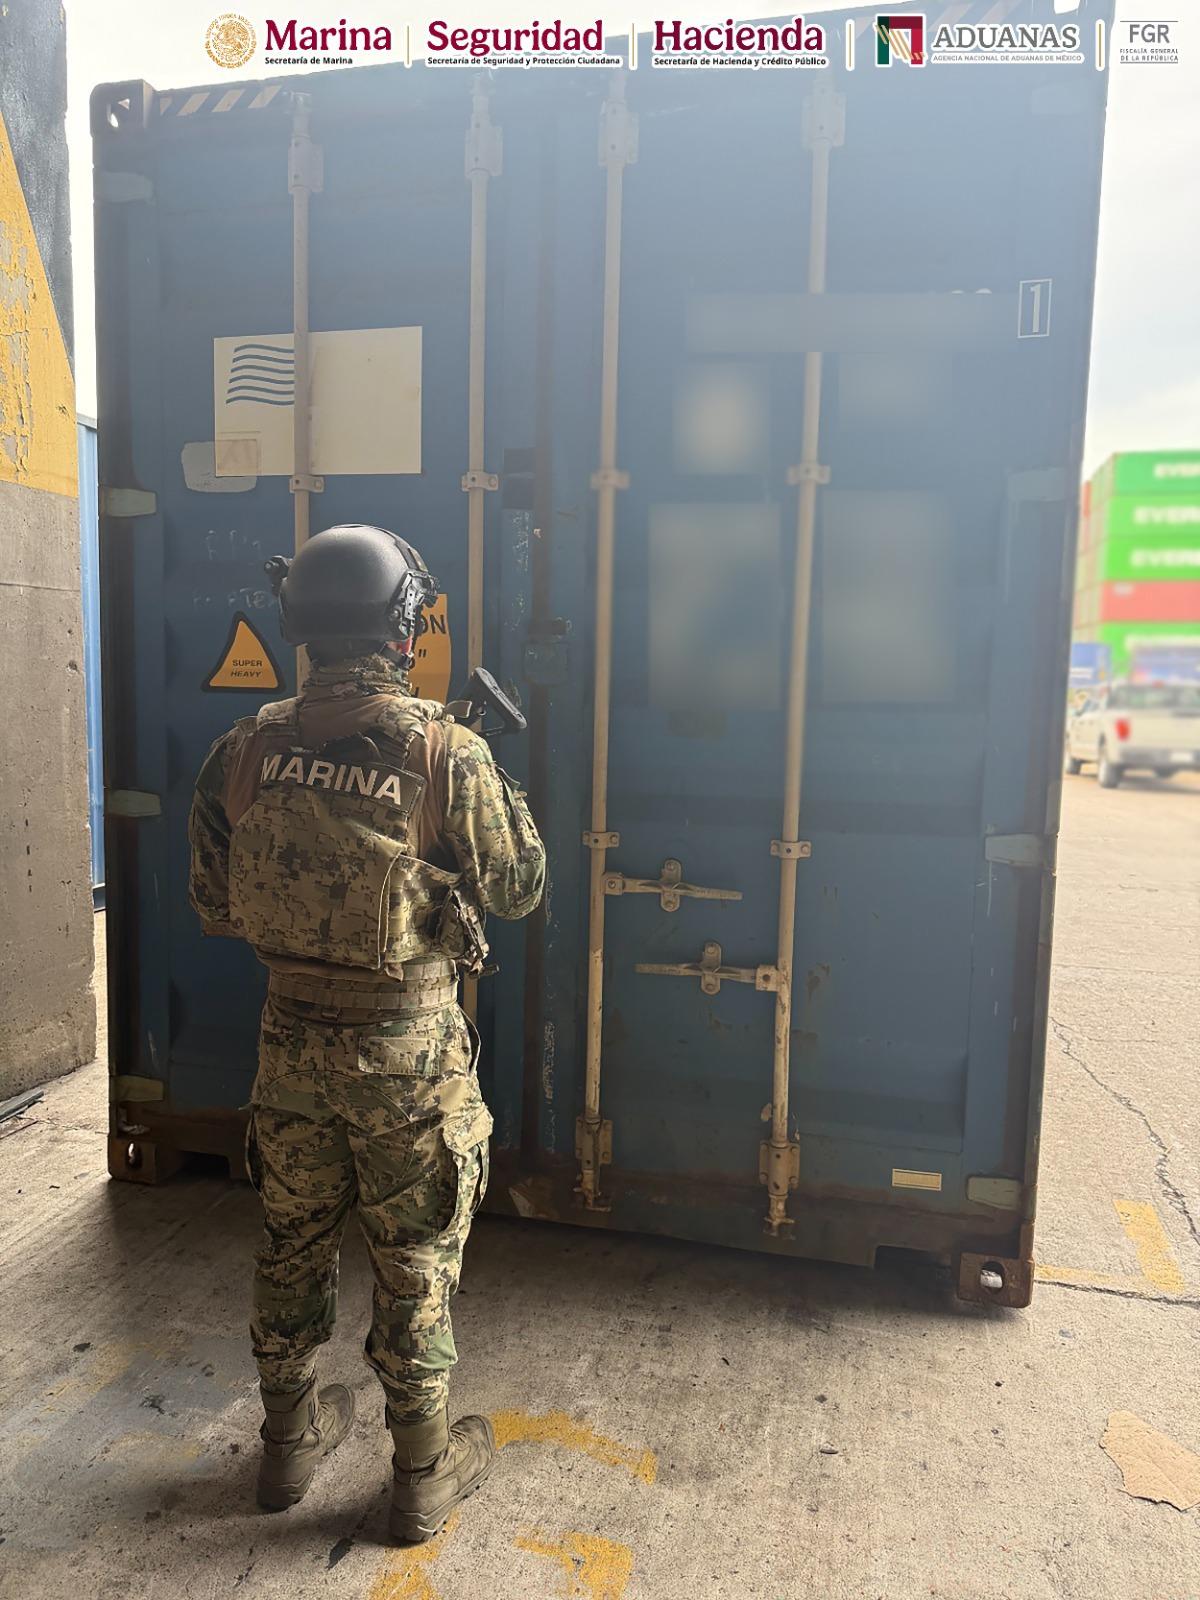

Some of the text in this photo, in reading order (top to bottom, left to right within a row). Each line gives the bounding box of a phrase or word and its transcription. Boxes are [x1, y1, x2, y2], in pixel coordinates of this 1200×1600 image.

[1030, 283, 1041, 333] 1
[230, 670, 263, 678] HEAVY
[232, 659, 263, 667] SUPER
[260, 754, 402, 806] MARINA
